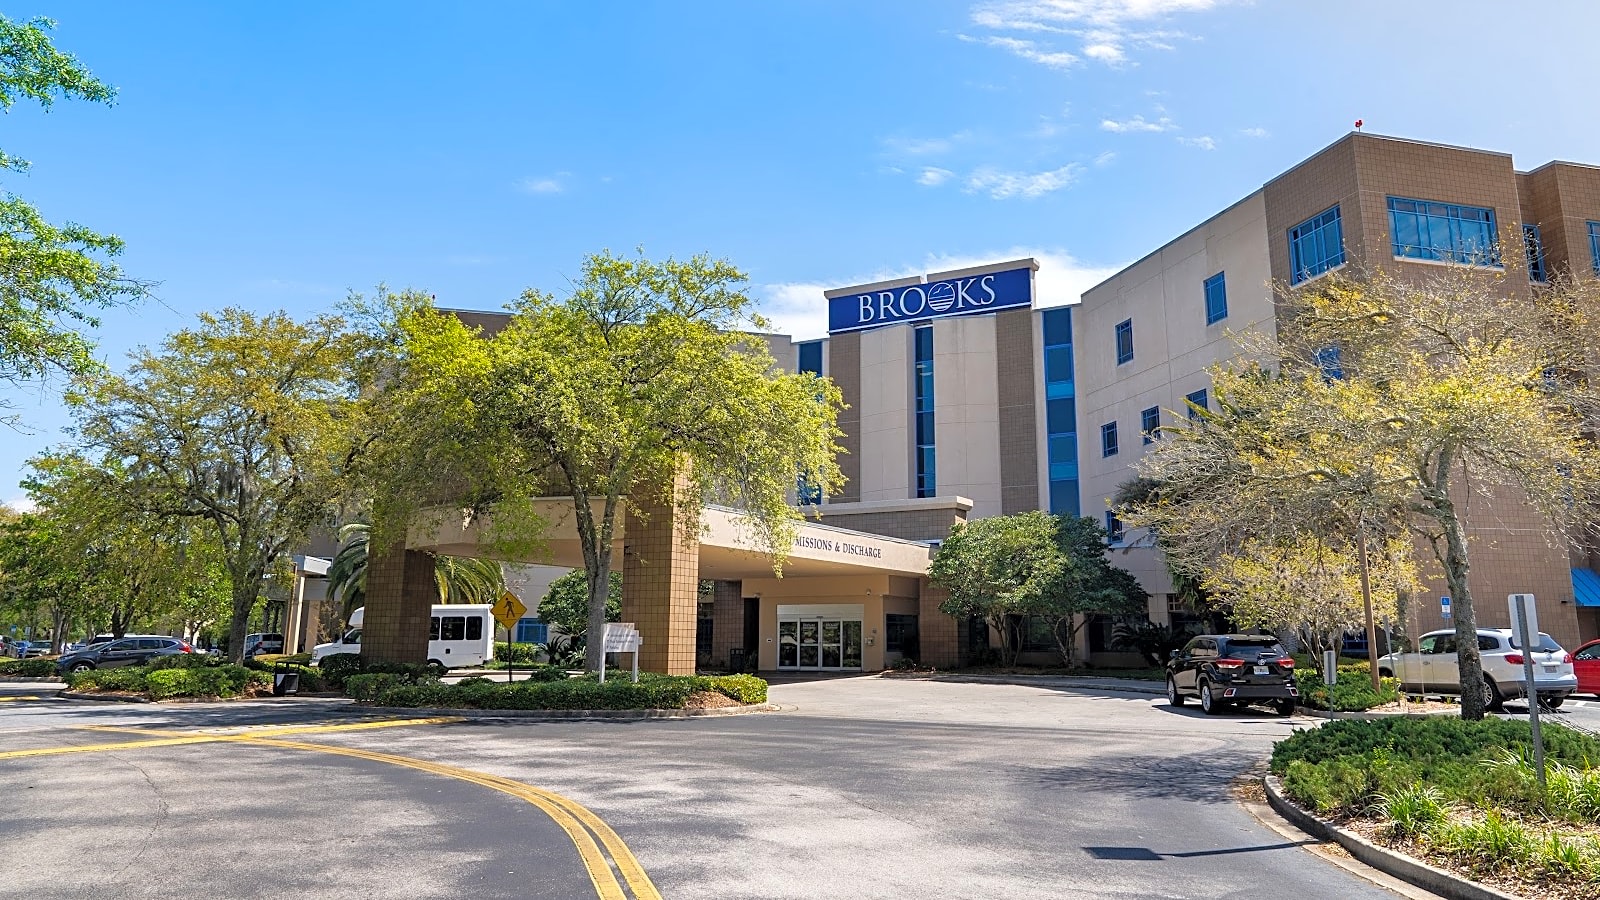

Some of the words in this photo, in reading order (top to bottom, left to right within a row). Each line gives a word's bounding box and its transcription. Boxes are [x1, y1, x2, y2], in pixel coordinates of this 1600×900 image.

[857, 275, 996, 323] BROOKS
[794, 535, 832, 551] MISSIONS
[834, 541, 840, 552] &
[842, 542, 882, 559] DISCHARGE
